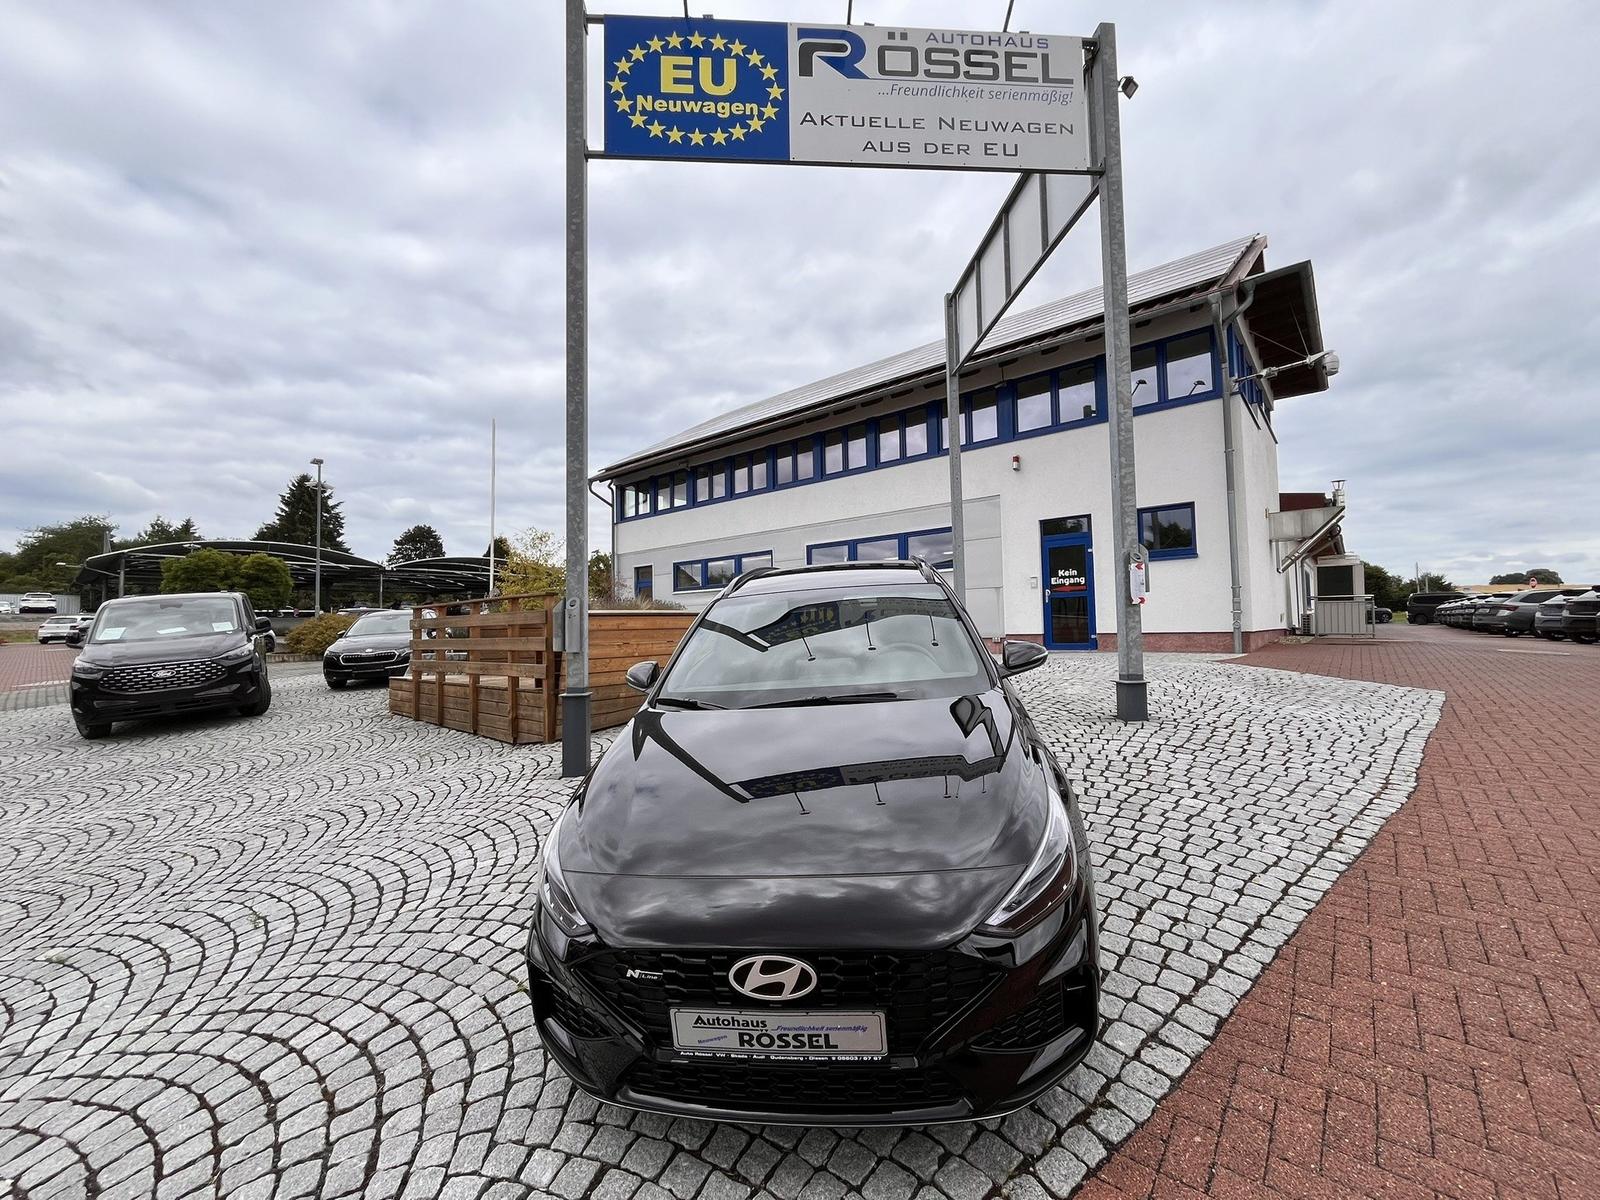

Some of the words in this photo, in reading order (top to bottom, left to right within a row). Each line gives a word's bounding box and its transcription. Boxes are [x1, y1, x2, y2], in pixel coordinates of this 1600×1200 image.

[925, 32, 1049, 49] AUTOHAUS
[797, 27, 1074, 85] RÖSSEL
[660, 55, 737, 96] EU
[636, 94, 759, 118] Neuwagen
[988, 89, 1074, 106] serienmäßig!
[799, 111, 926, 130] AKTUELLE
[938, 116, 1075, 135] NEUWAGEN
[862, 140, 911, 153] AUS
[924, 142, 970, 155] DER
[983, 143, 1019, 157] EU
[1058, 568, 1078, 576] Kein
[1051, 576, 1085, 586] Eingang
[626, 969, 641, 978] N
[693, 1014, 768, 1028] Autohaus
[738, 1028, 839, 1049] RÖSSEL
